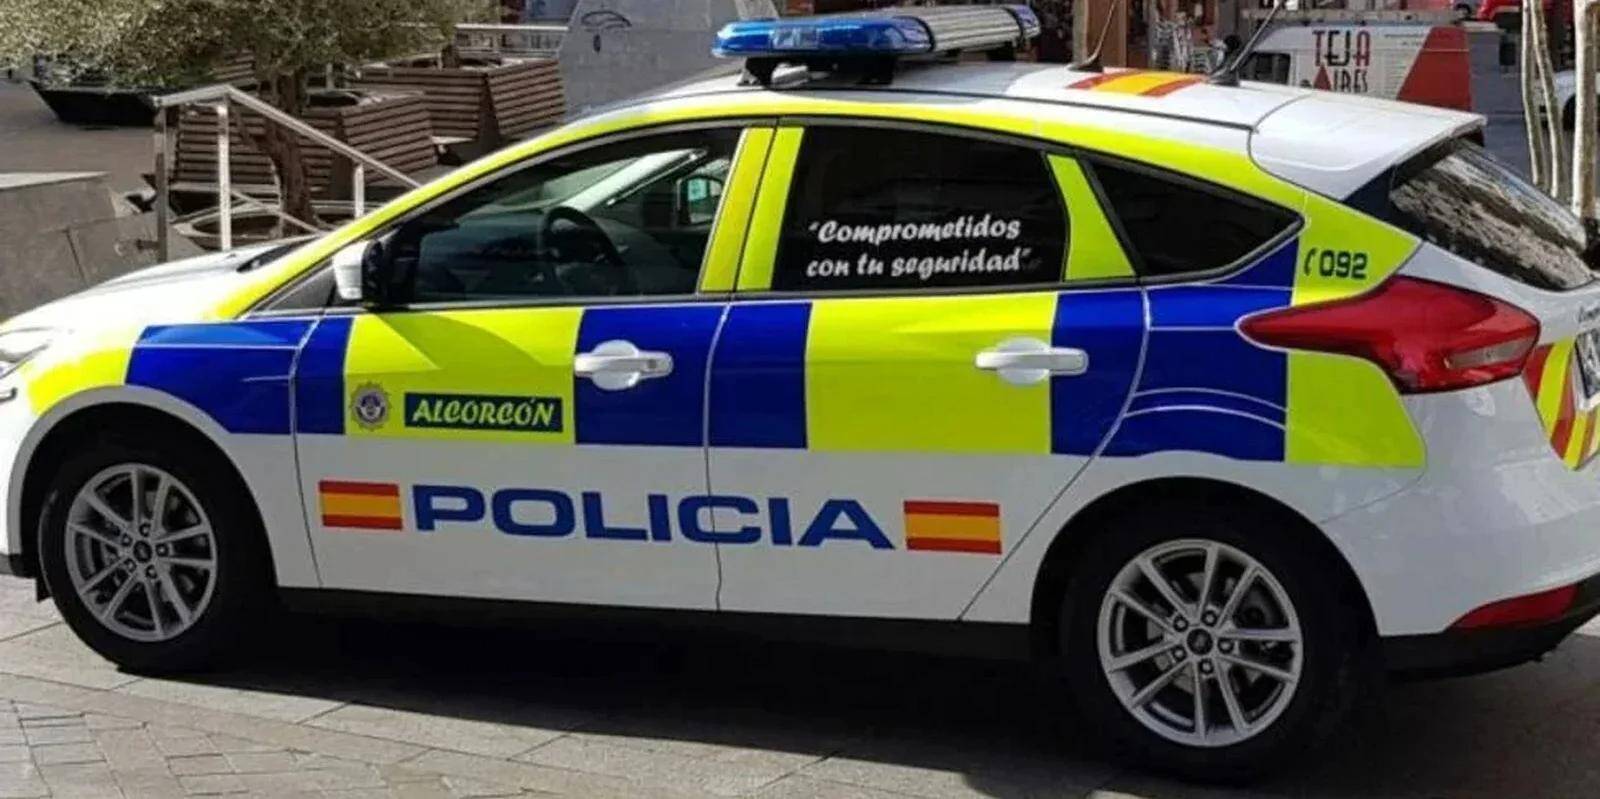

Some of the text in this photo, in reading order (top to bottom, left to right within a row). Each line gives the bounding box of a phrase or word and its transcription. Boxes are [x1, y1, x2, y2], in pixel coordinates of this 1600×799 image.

[1312, 29, 1371, 67] TEJA
[806, 258, 850, 277] con
[857, 252, 884, 275] tu
[1319, 249, 1368, 280] 092
[411, 398, 555, 427] ALCORCÓN
[412, 484, 896, 551] POLICIA
